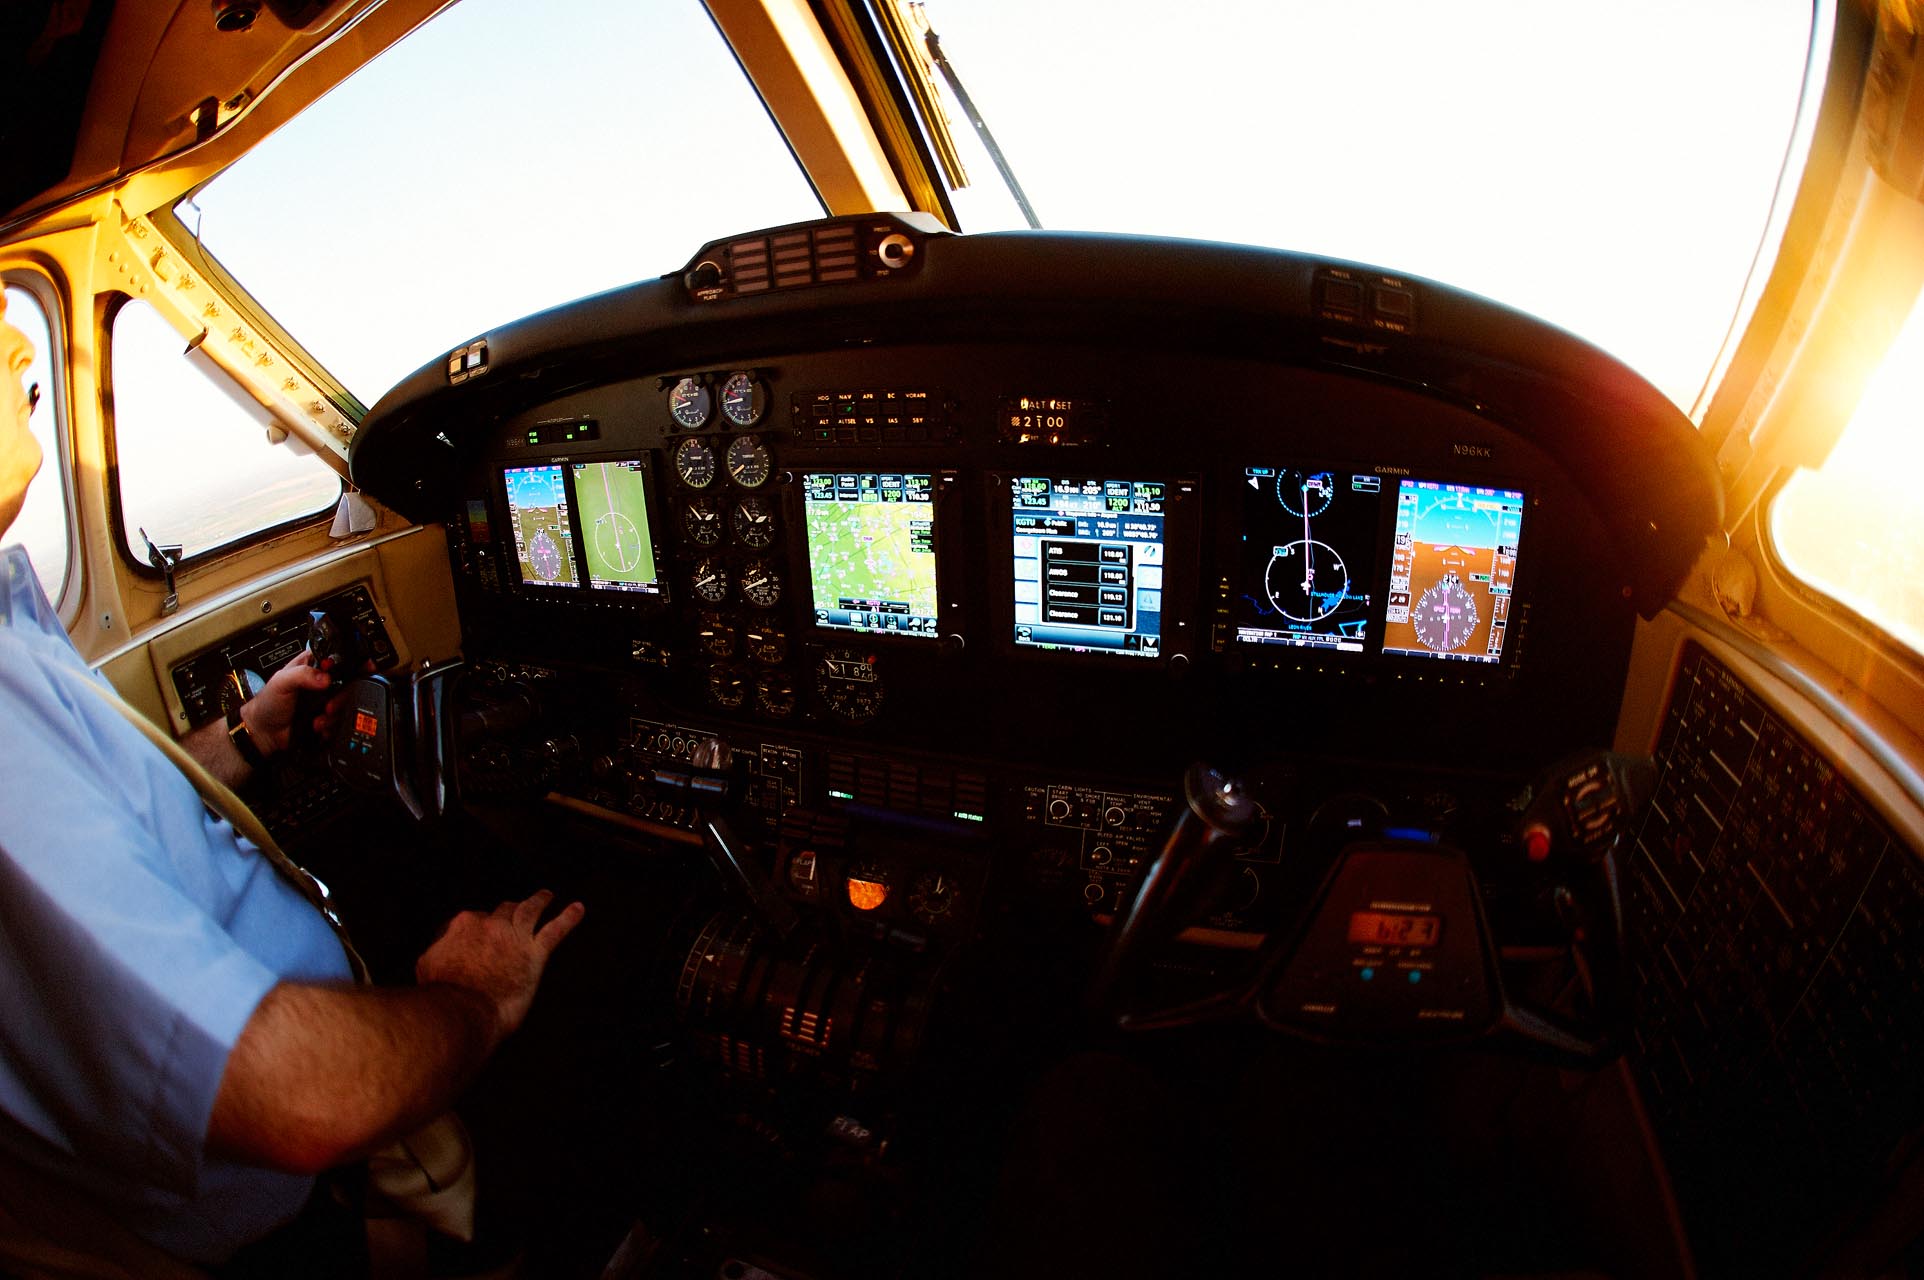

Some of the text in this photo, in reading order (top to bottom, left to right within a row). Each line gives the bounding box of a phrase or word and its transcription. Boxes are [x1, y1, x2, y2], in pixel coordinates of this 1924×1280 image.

[1056, 401, 1072, 410] SET
[1454, 443, 1492, 458] N96KK
[1374, 466, 1410, 476] GARMIN
[883, 490, 902, 498] 1200
[1108, 498, 1128, 506] 1200
[1016, 518, 1036, 526] KGTU
